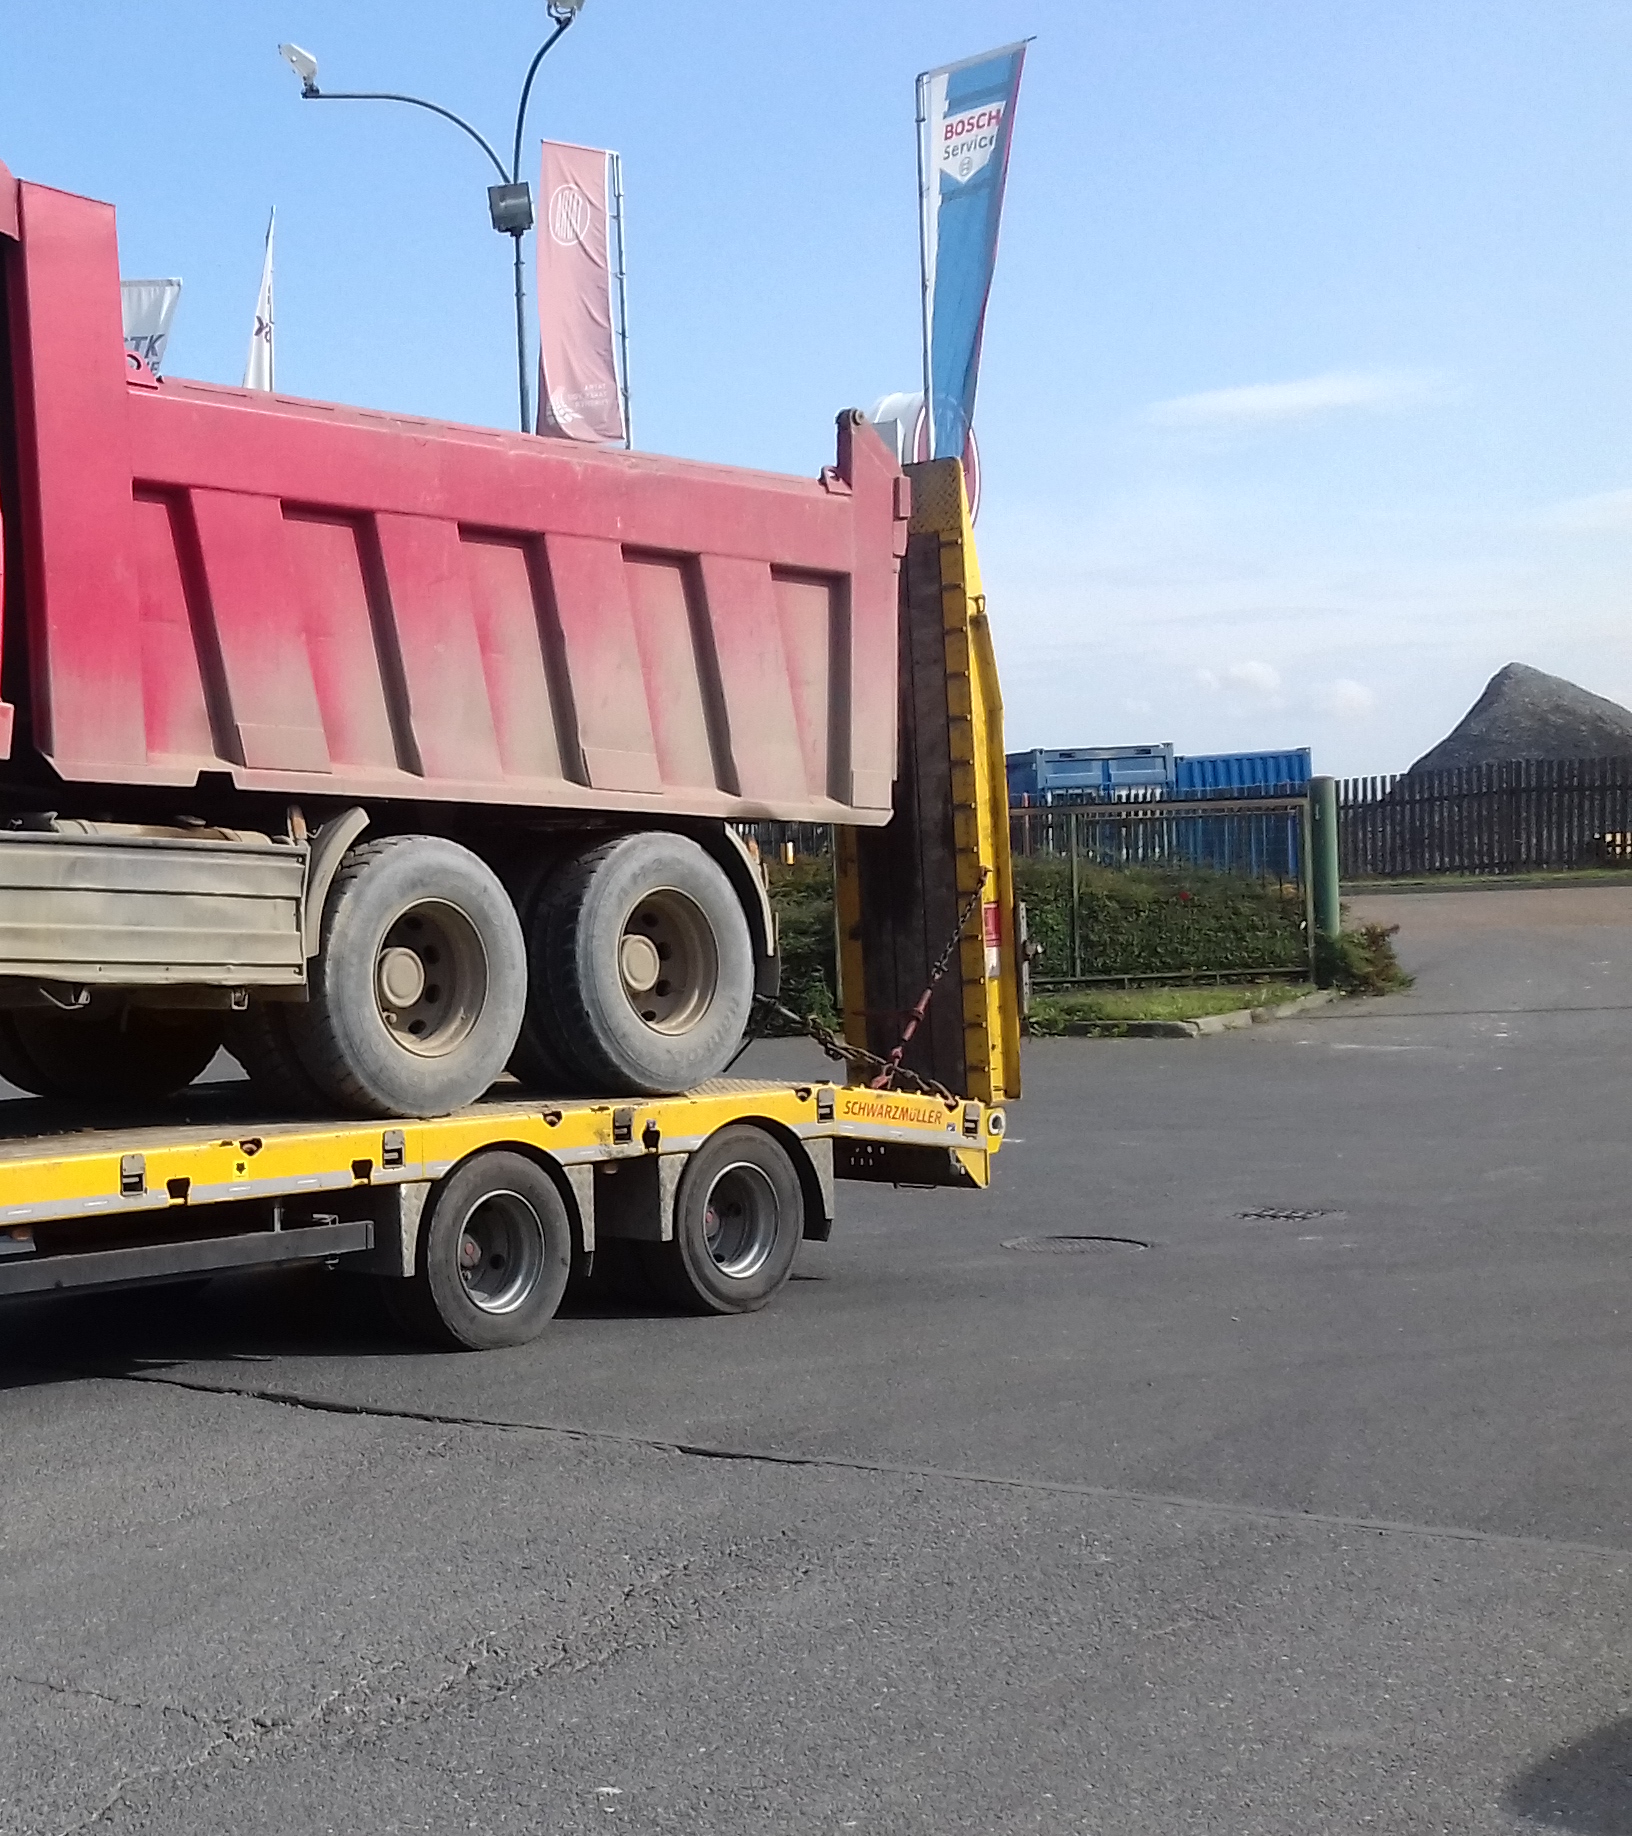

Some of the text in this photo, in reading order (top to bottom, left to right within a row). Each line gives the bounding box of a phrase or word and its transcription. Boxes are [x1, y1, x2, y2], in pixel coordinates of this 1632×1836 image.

[943, 108, 1002, 141] BOSCH
[125, 333, 165, 359] TK
[843, 1100, 942, 1125] SCHWARZMÜLLER
